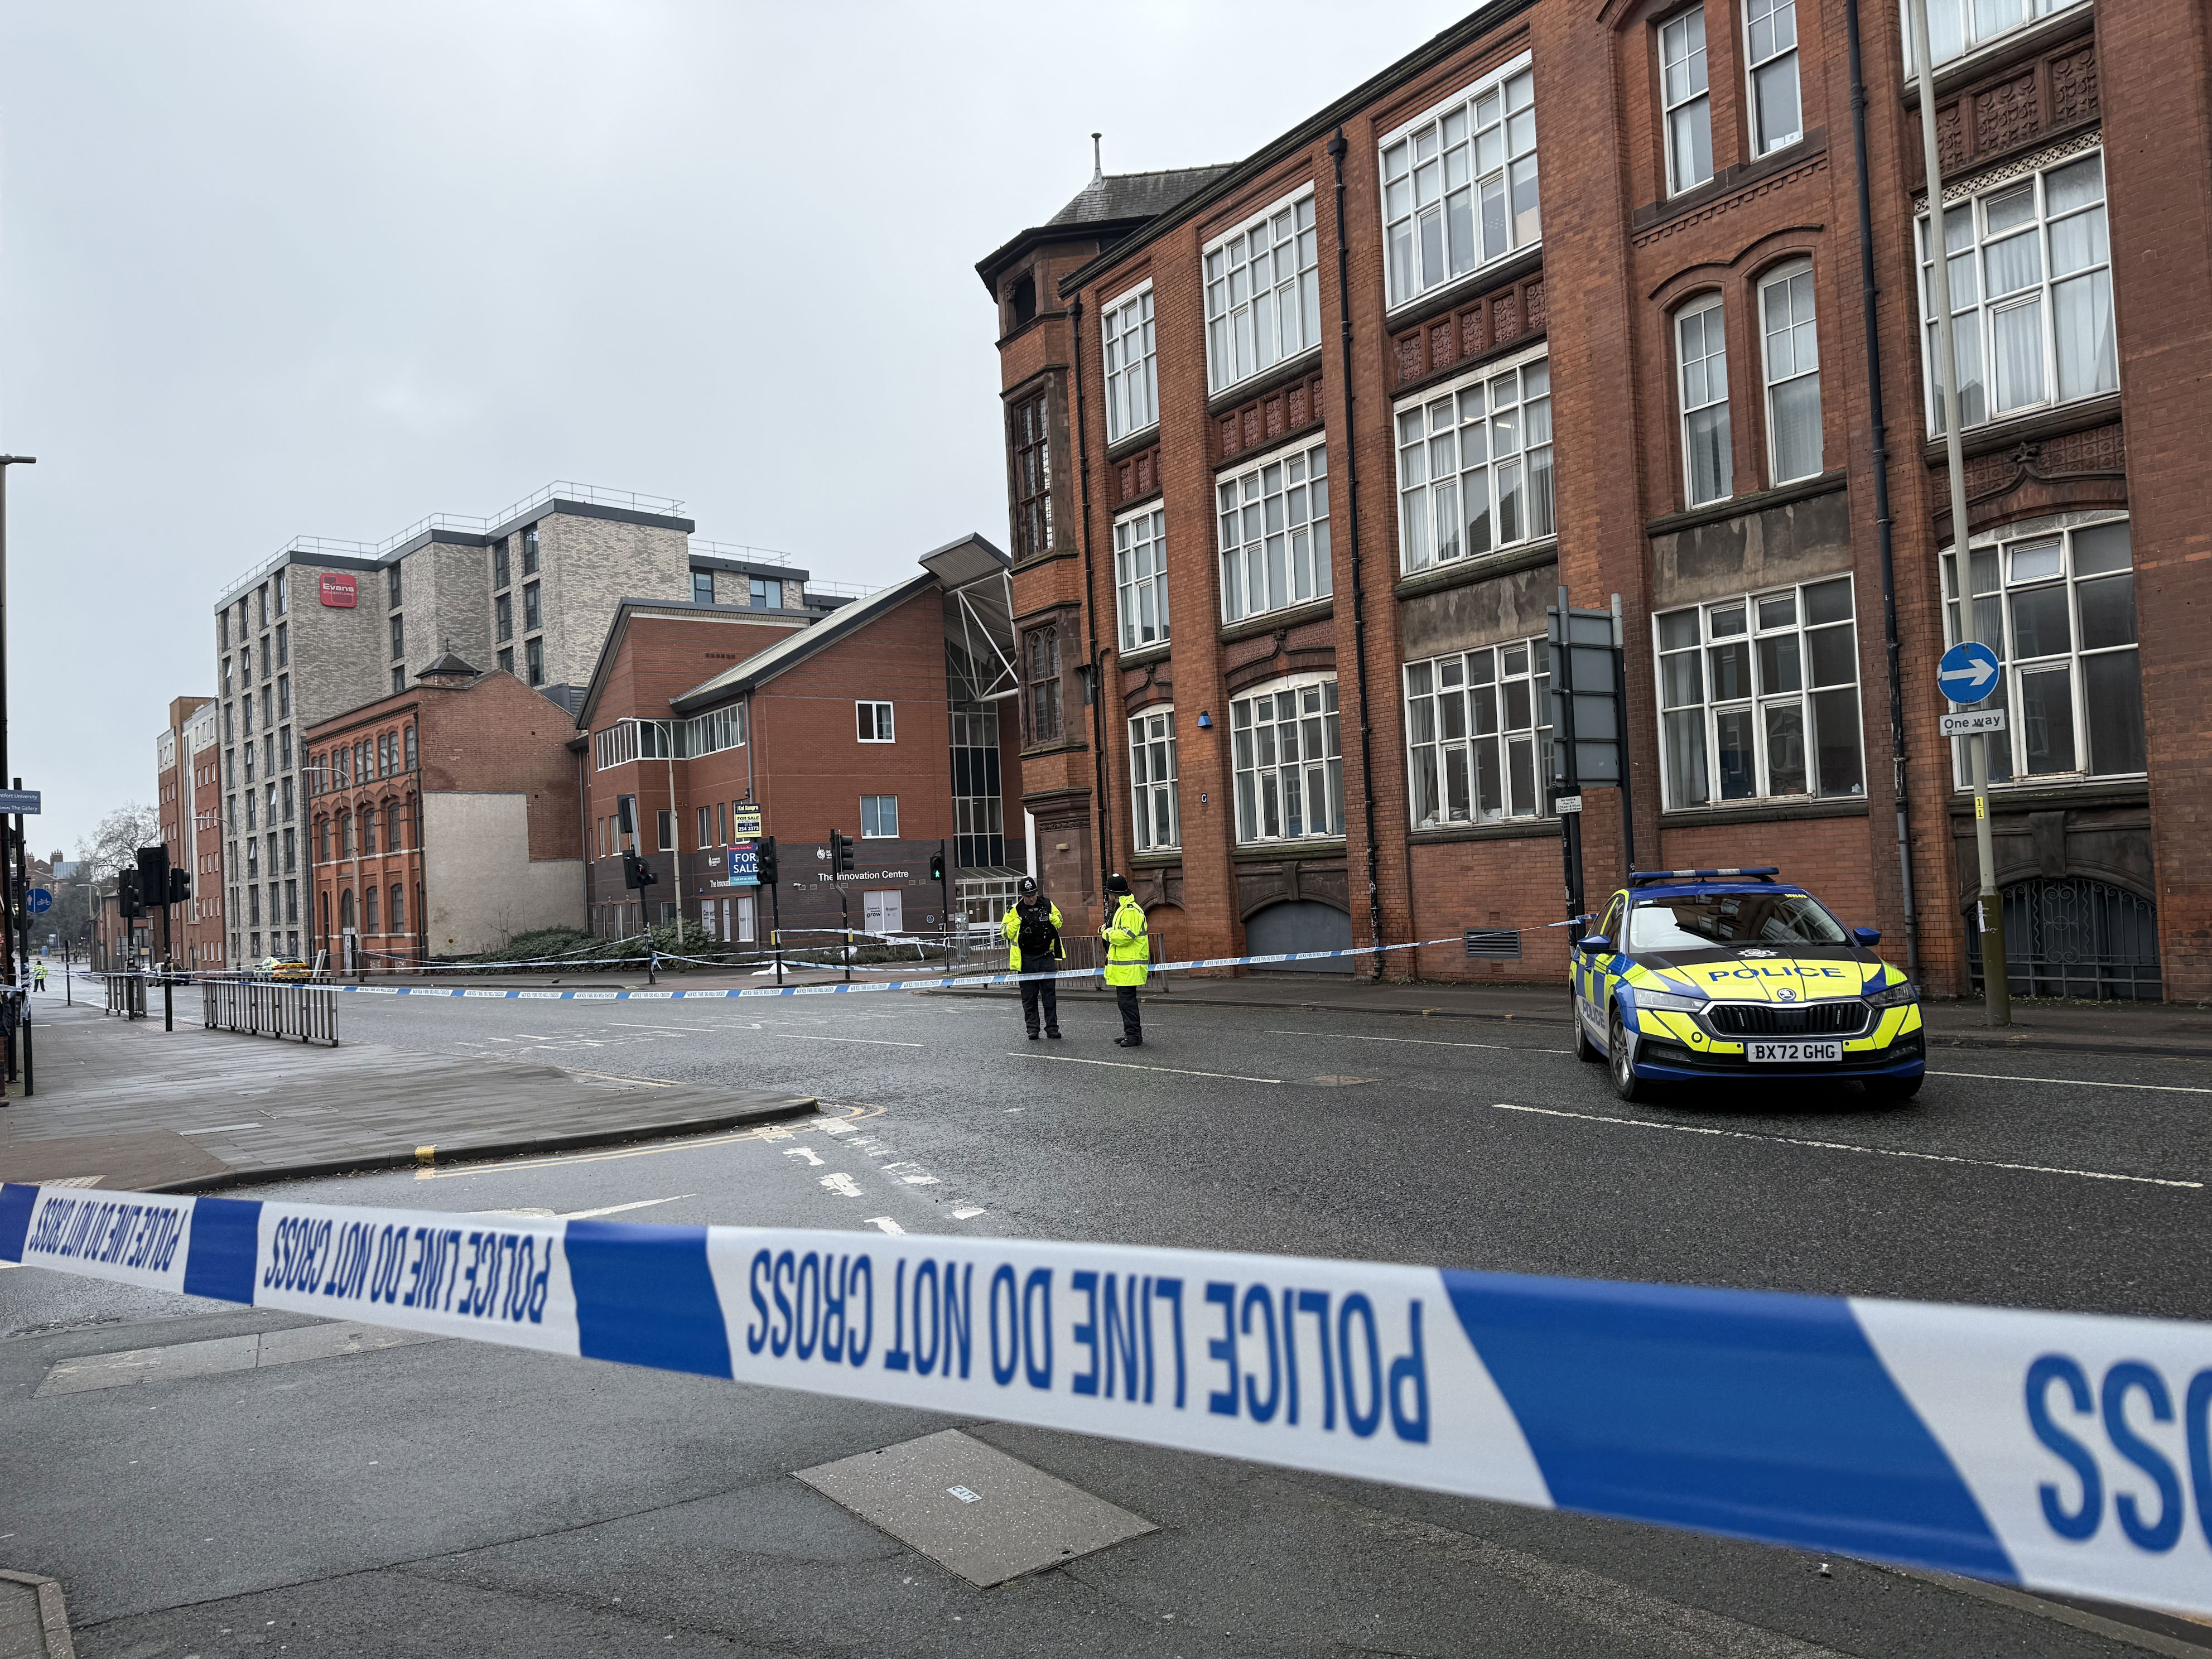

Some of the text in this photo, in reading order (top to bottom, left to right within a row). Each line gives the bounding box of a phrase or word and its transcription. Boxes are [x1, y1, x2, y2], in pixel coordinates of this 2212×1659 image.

[323, 583, 354, 592] Evans
[1945, 716, 1999, 729] One way
[735, 853, 756, 862] FOR
[734, 864, 759, 874] SALE
[837, 871, 879, 880] Innovation
[1708, 967, 1845, 981] POLICE
[1582, 999, 1606, 1030] POLICE
[1755, 1045, 1835, 1059] BX72 GHG
[28, 1197, 187, 1271] POLICE LINE DO NOT CROSS
[264, 1216, 553, 1324] POLICE LINE DO NOT CROSS
[748, 1248, 1430, 1445] POLICE LINE DO NOT CROSS
[953, 1487, 979, 1500] CATV
